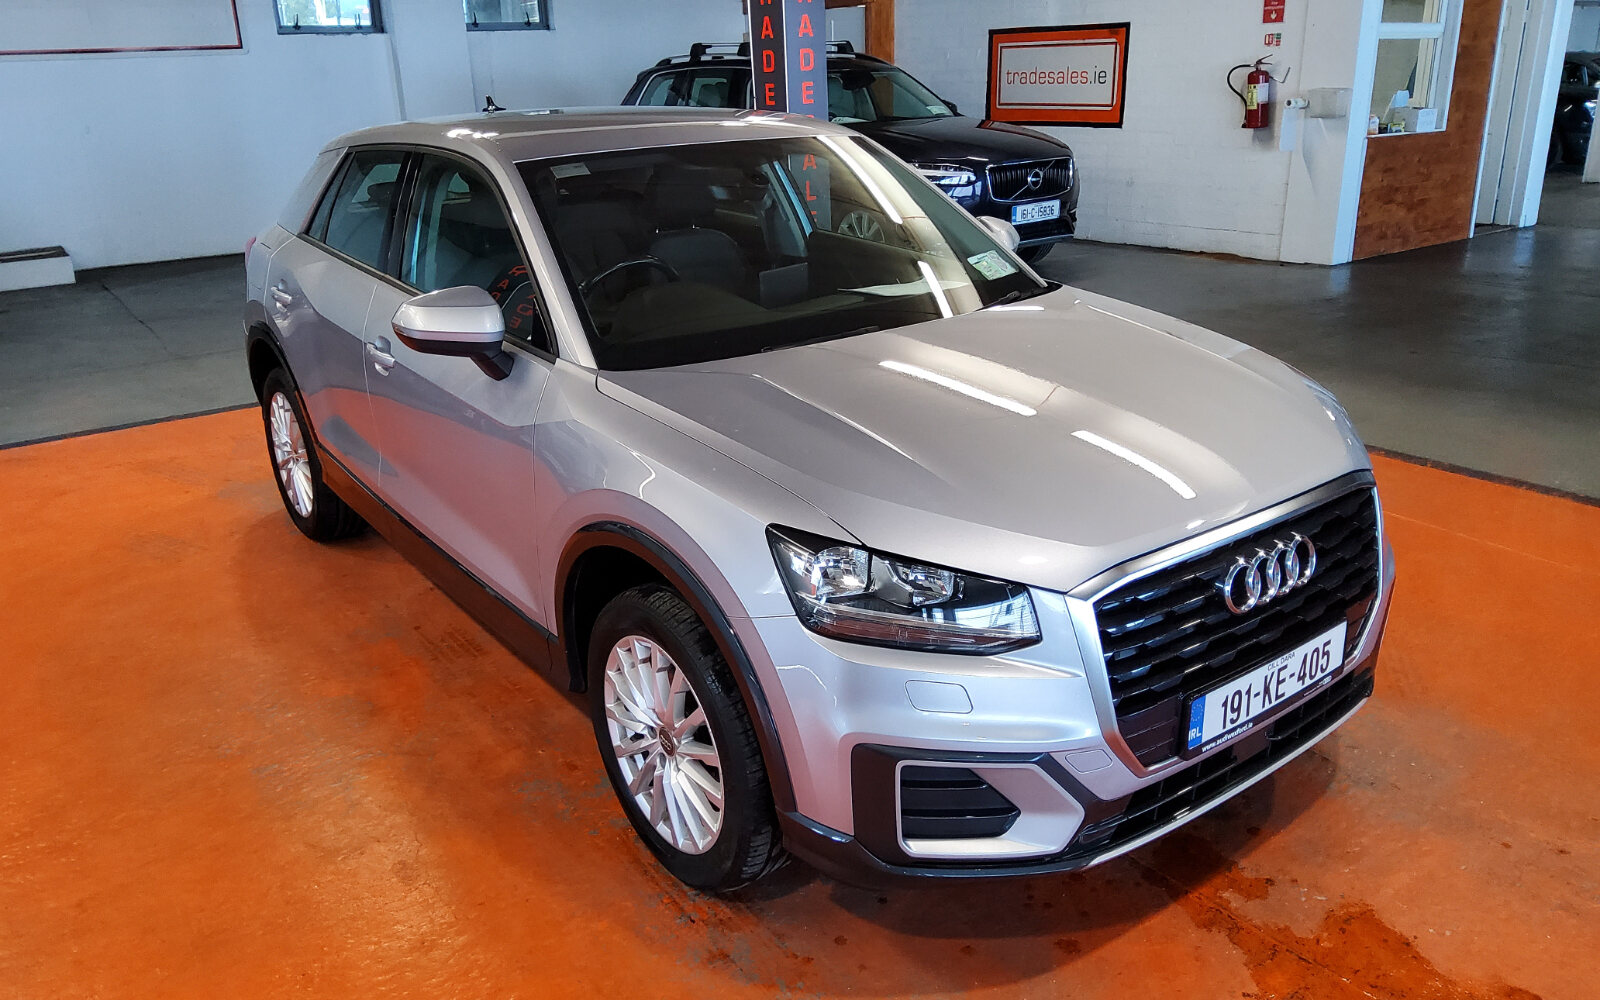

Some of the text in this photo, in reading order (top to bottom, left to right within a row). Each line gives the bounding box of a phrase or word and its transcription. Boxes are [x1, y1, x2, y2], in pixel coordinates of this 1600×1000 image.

[760, 0, 776, 106] ADE
[797, 0, 815, 104] ADE
[1005, 65, 1107, 85] tradesales.ie
[1221, 639, 1332, 730] 191-KE-405
[1188, 726, 1202, 742] IRL
